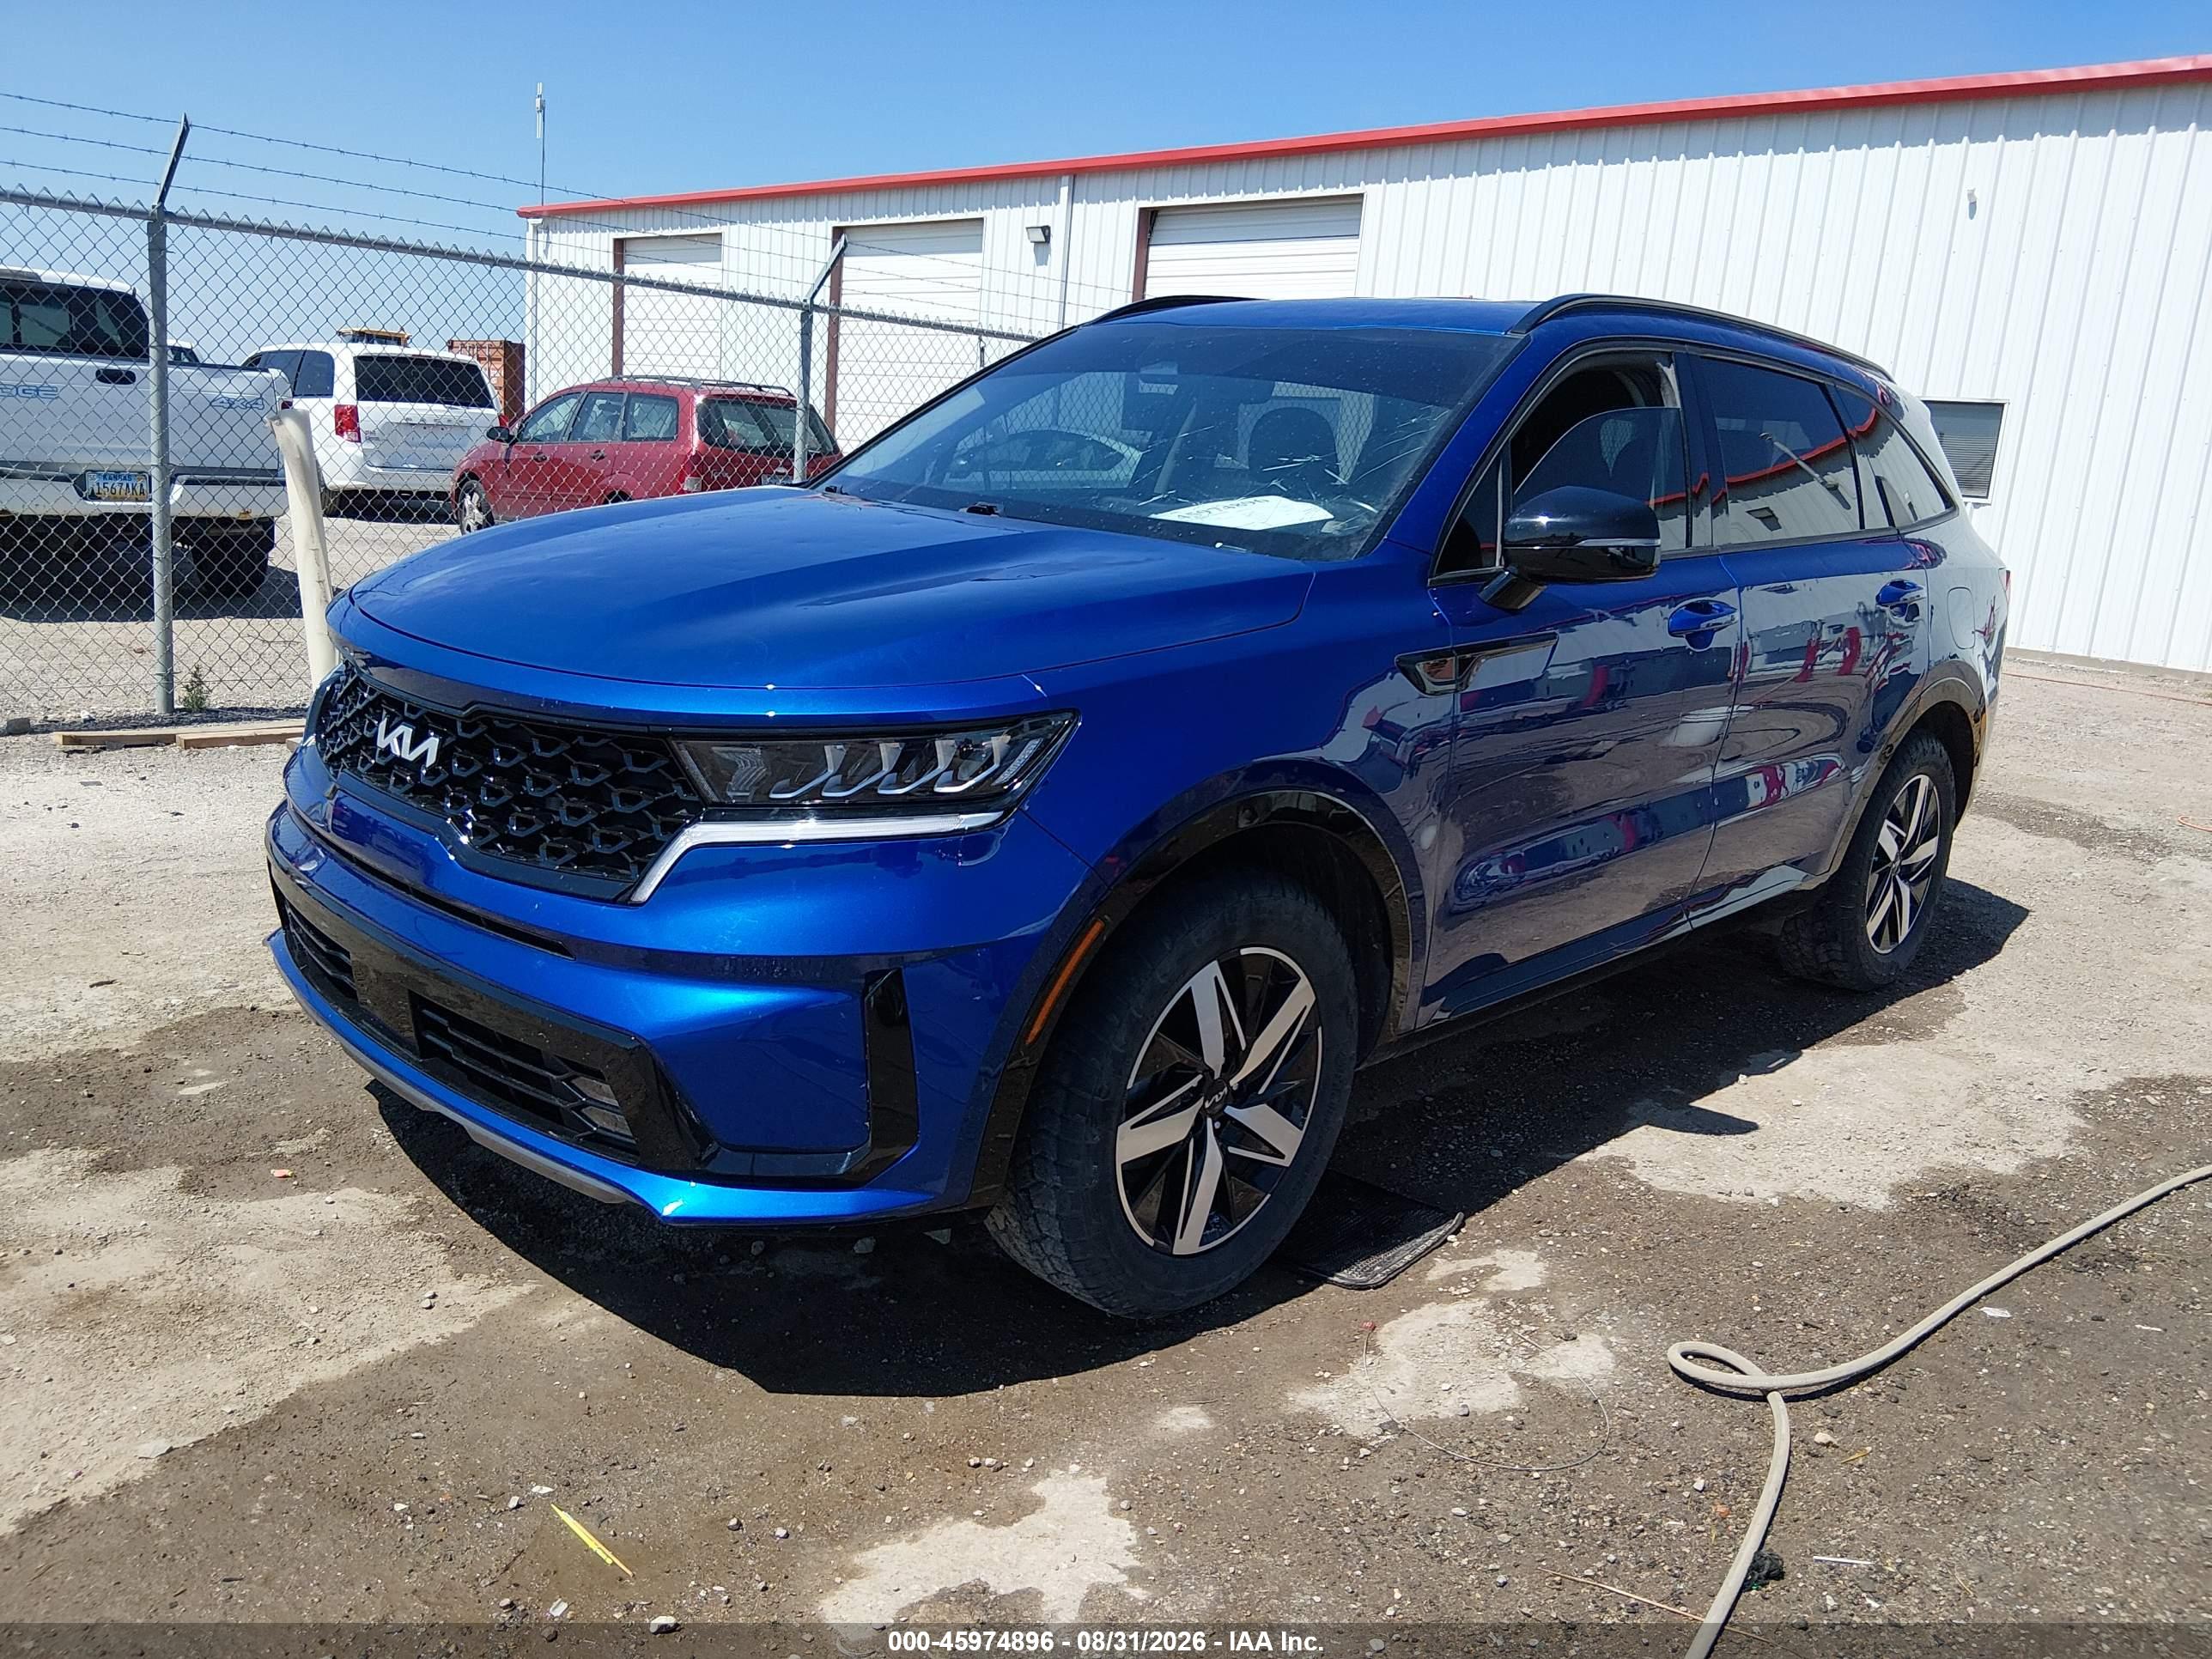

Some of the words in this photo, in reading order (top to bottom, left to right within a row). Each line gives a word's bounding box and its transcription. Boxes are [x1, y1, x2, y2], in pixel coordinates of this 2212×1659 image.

[103, 473, 132, 482] KANSAS
[96, 482, 146, 495] 1567AKA
[376, 717, 440, 769] KIA
